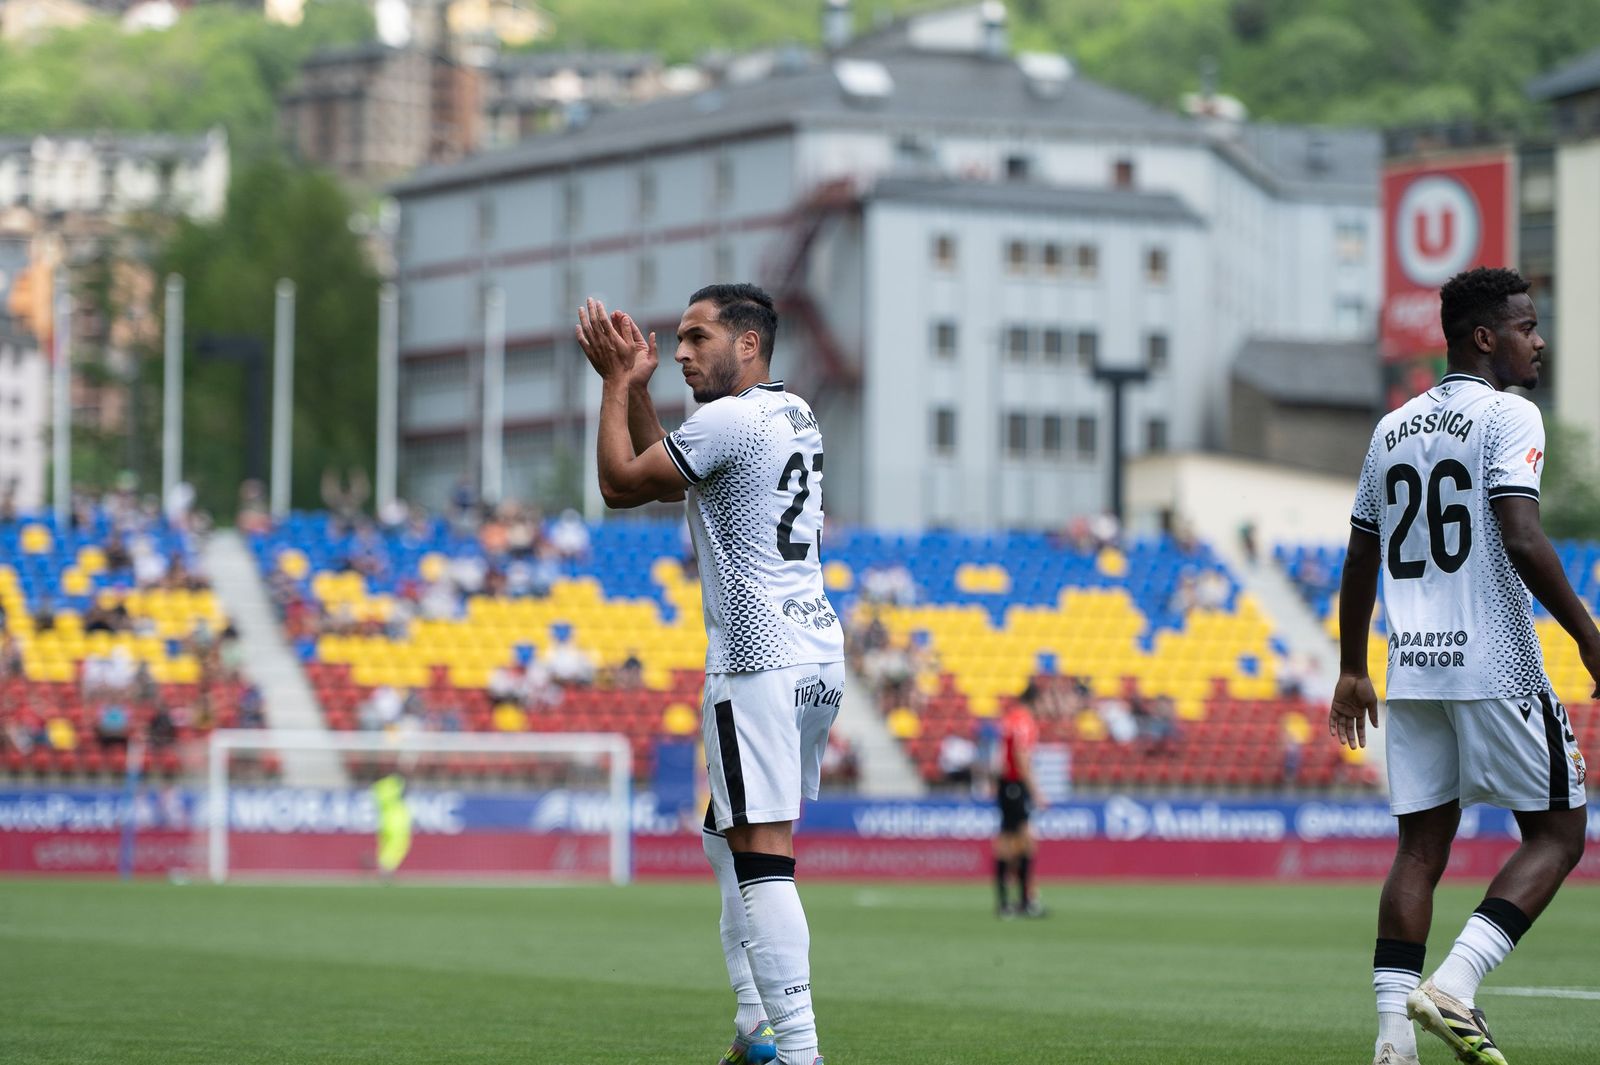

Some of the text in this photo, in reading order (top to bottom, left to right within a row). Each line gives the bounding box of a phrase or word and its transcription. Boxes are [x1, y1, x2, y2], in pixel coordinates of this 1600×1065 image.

[1414, 209, 1454, 257] U
[1387, 458, 1473, 580] 26
[1400, 630, 1468, 647] DARYSO
[1400, 651, 1465, 667] MOTOR
